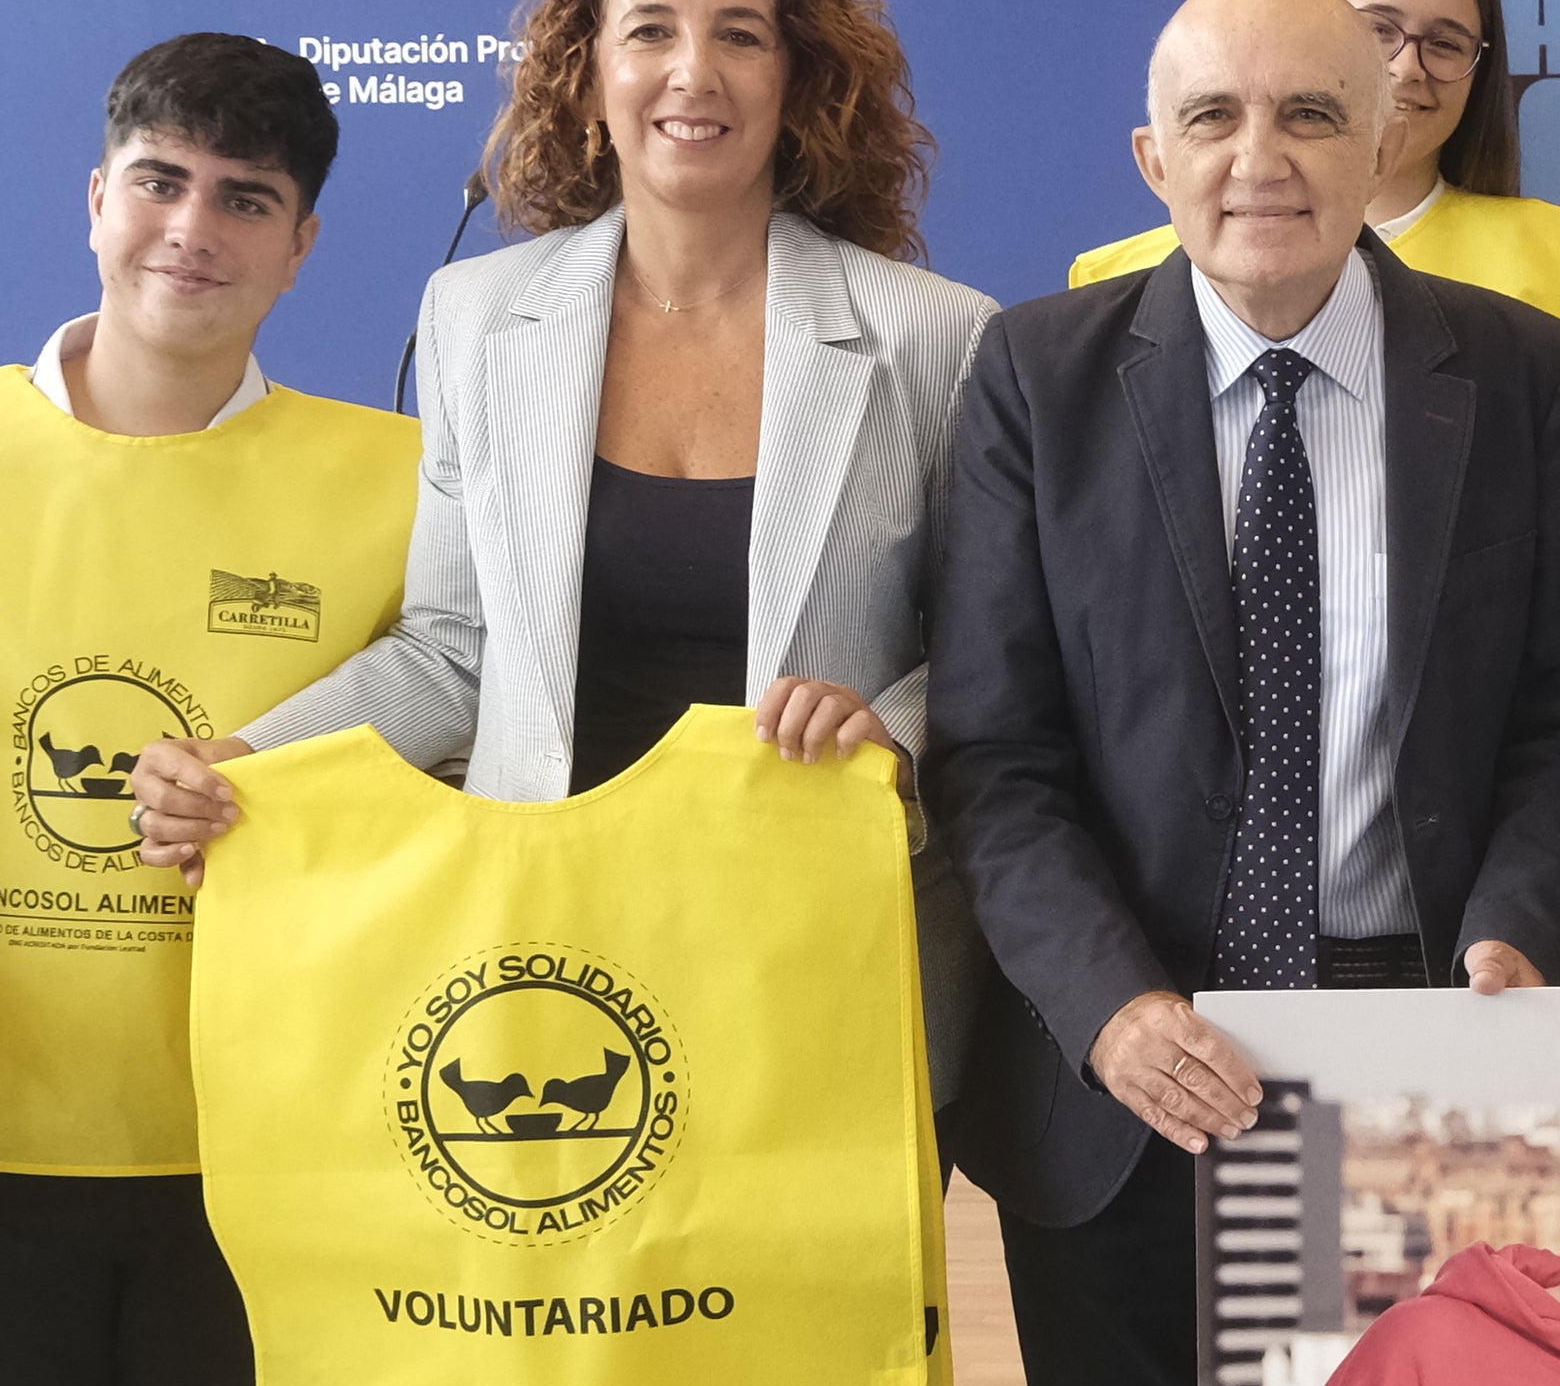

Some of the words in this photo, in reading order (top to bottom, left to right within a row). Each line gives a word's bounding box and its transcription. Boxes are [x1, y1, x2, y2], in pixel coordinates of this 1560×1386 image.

[299, 34, 468, 71] Diputación
[349, 74, 464, 110] Málaga
[218, 610, 310, 630] CARRETILLA
[12, 664, 67, 751] BANCOS
[74, 655, 110, 675] DE
[118, 659, 214, 741] ALIMENTO
[11, 771, 65, 863] BANCOS
[65, 851, 98, 873] DE
[96, 893, 195, 915] ALIMEN
[5, 924, 20, 935] DE
[22, 926, 91, 940] ALIMENTOS
[95, 929, 113, 940] DE
[117, 930, 133, 940] LA
[137, 931, 182, 942] COSTA
[396, 1023, 434, 1072] YO
[425, 961, 488, 1024] SOY
[498, 953, 672, 1066] SOLIDARIO
[396, 1100, 529, 1235] BANCOSOL
[536, 1091, 679, 1235] ALIMENTOS
[374, 1286, 736, 1338] VOLUNTARIADO
